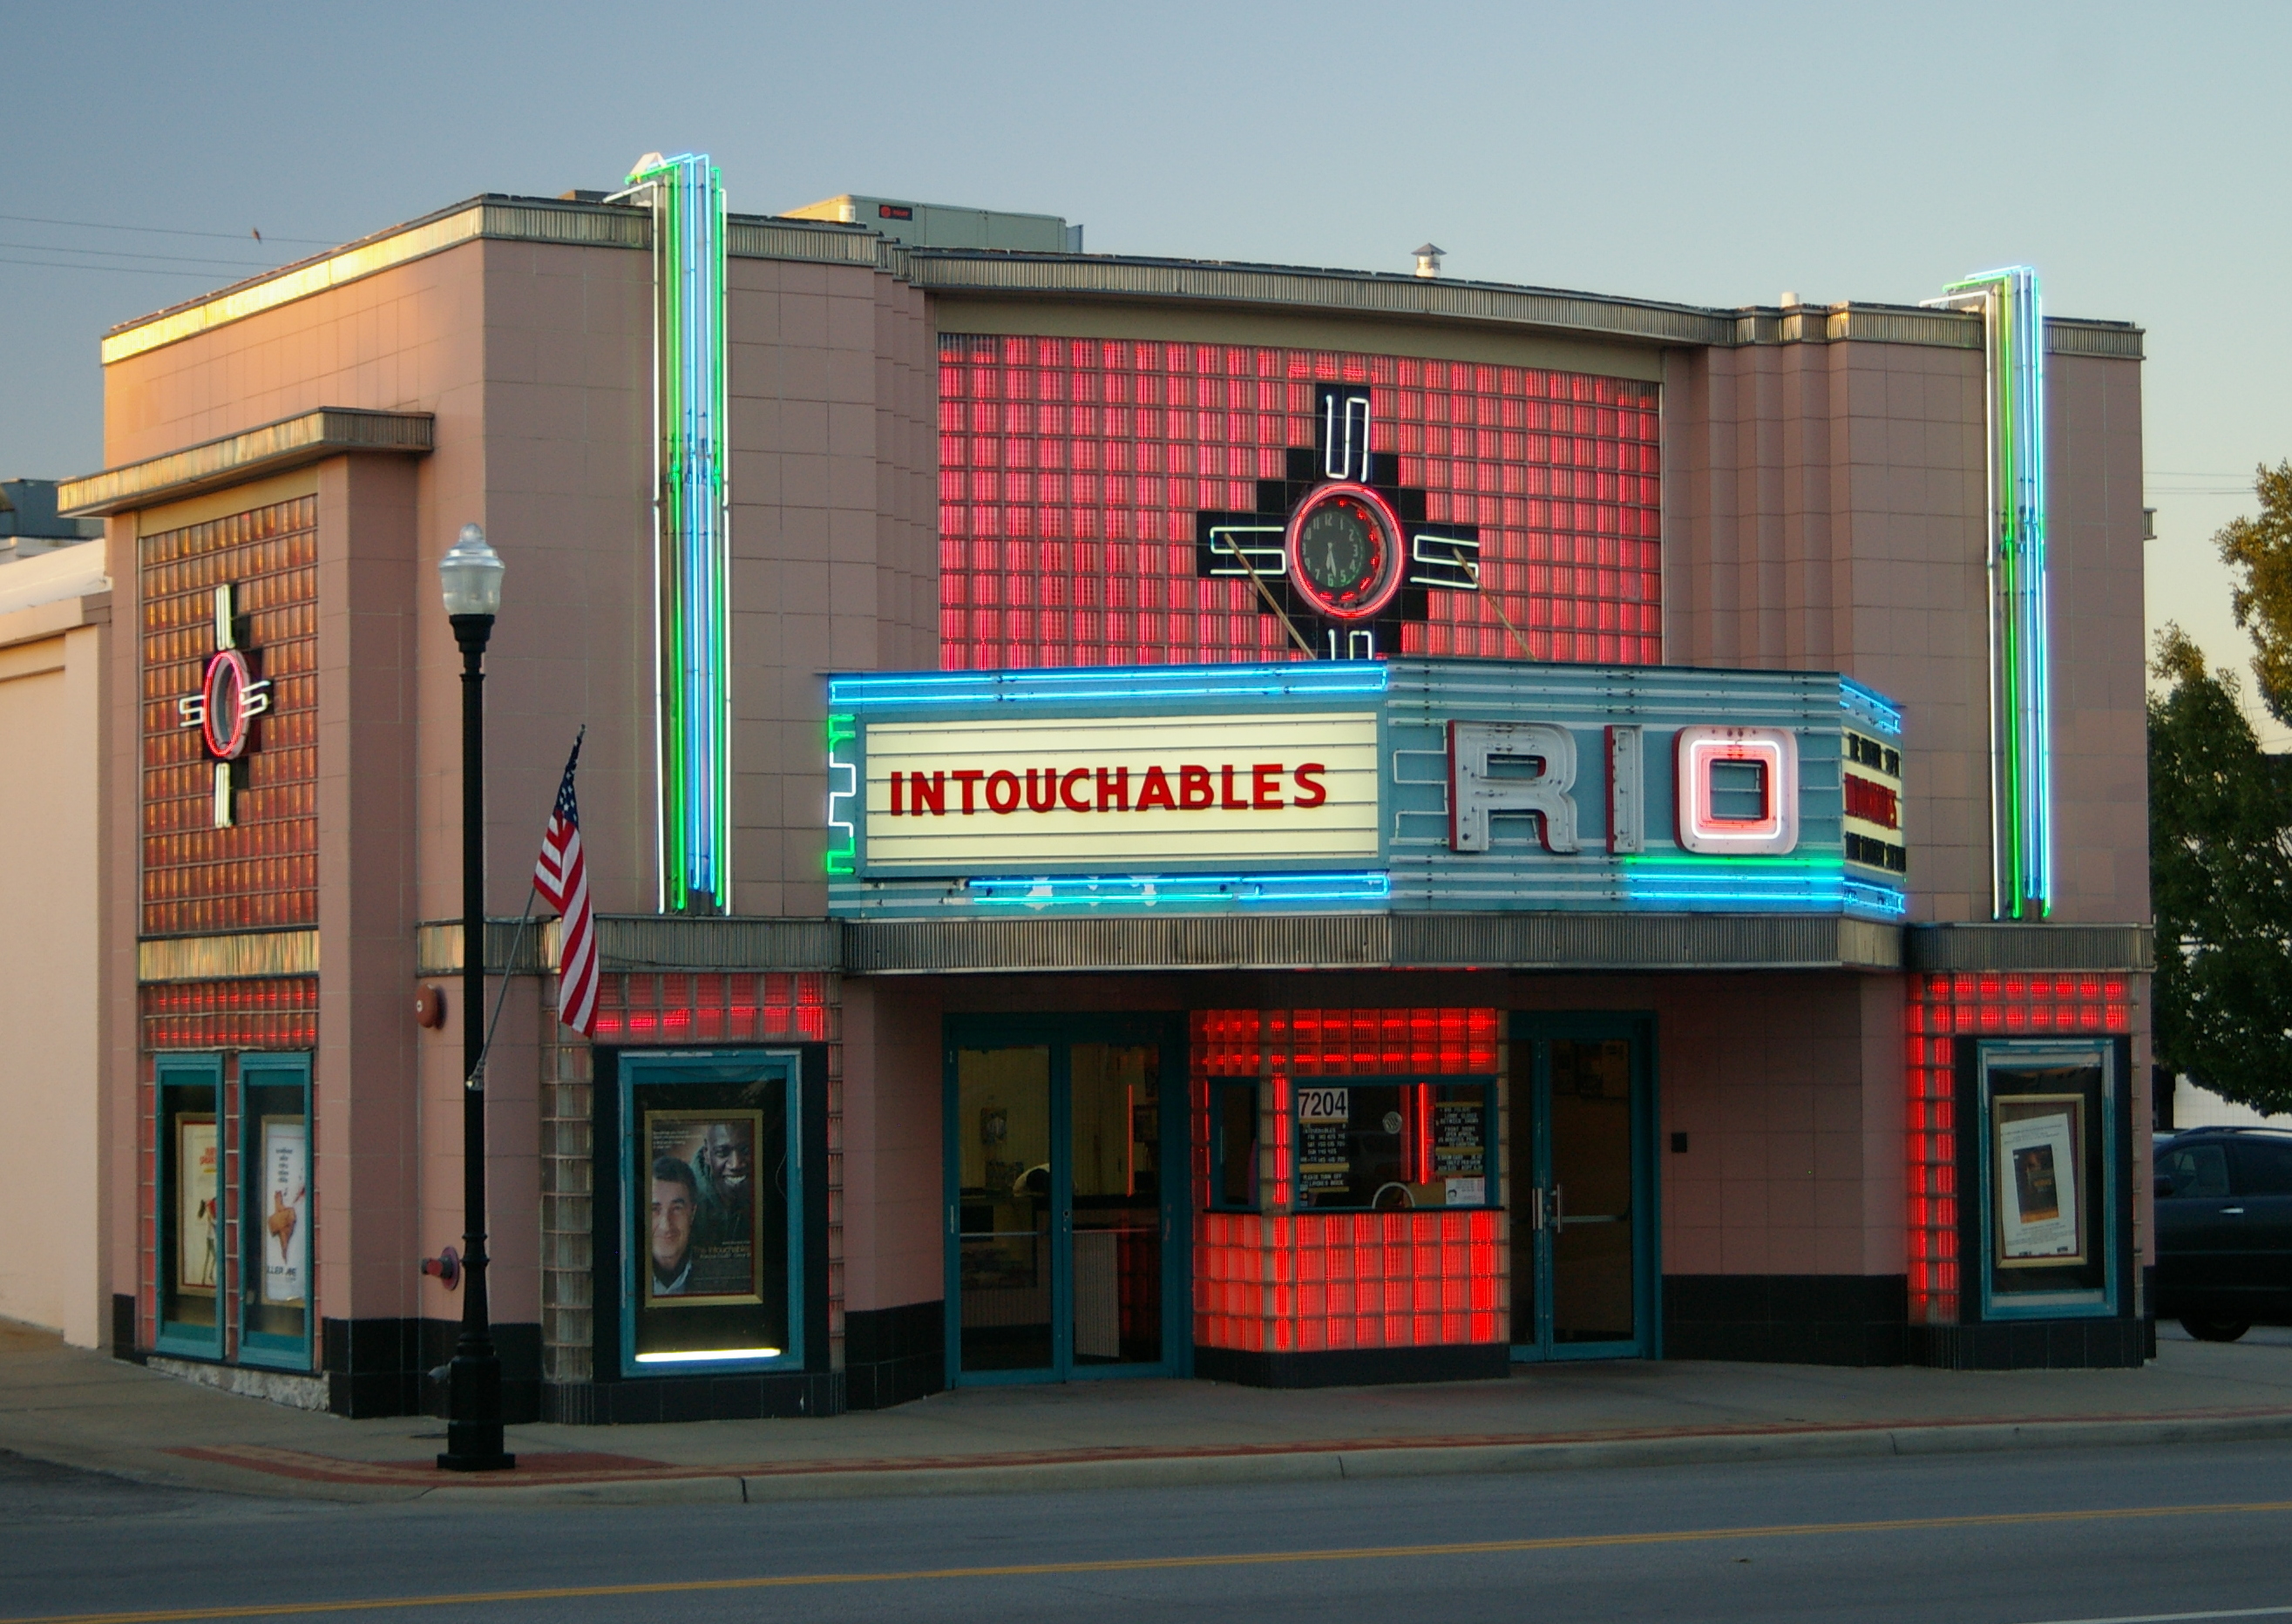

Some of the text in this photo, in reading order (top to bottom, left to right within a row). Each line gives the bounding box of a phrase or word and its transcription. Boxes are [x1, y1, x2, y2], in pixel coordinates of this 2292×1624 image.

[1313, 518, 1319, 530] 11
[1325, 513, 1332, 526] 12
[1303, 527, 1312, 540] 10
[1349, 529, 1354, 541] 2
[1353, 544, 1358, 557] 3
[1349, 558, 1356, 572] 4
[1314, 569, 1320, 581] 7
[1327, 573, 1334, 587] 6
[1340, 569, 1346, 583] 5
[890, 763, 1327, 816] INTOUCHABLES
[1448, 719, 1799, 856] RIO
[1299, 1092, 1346, 1117] 7204
